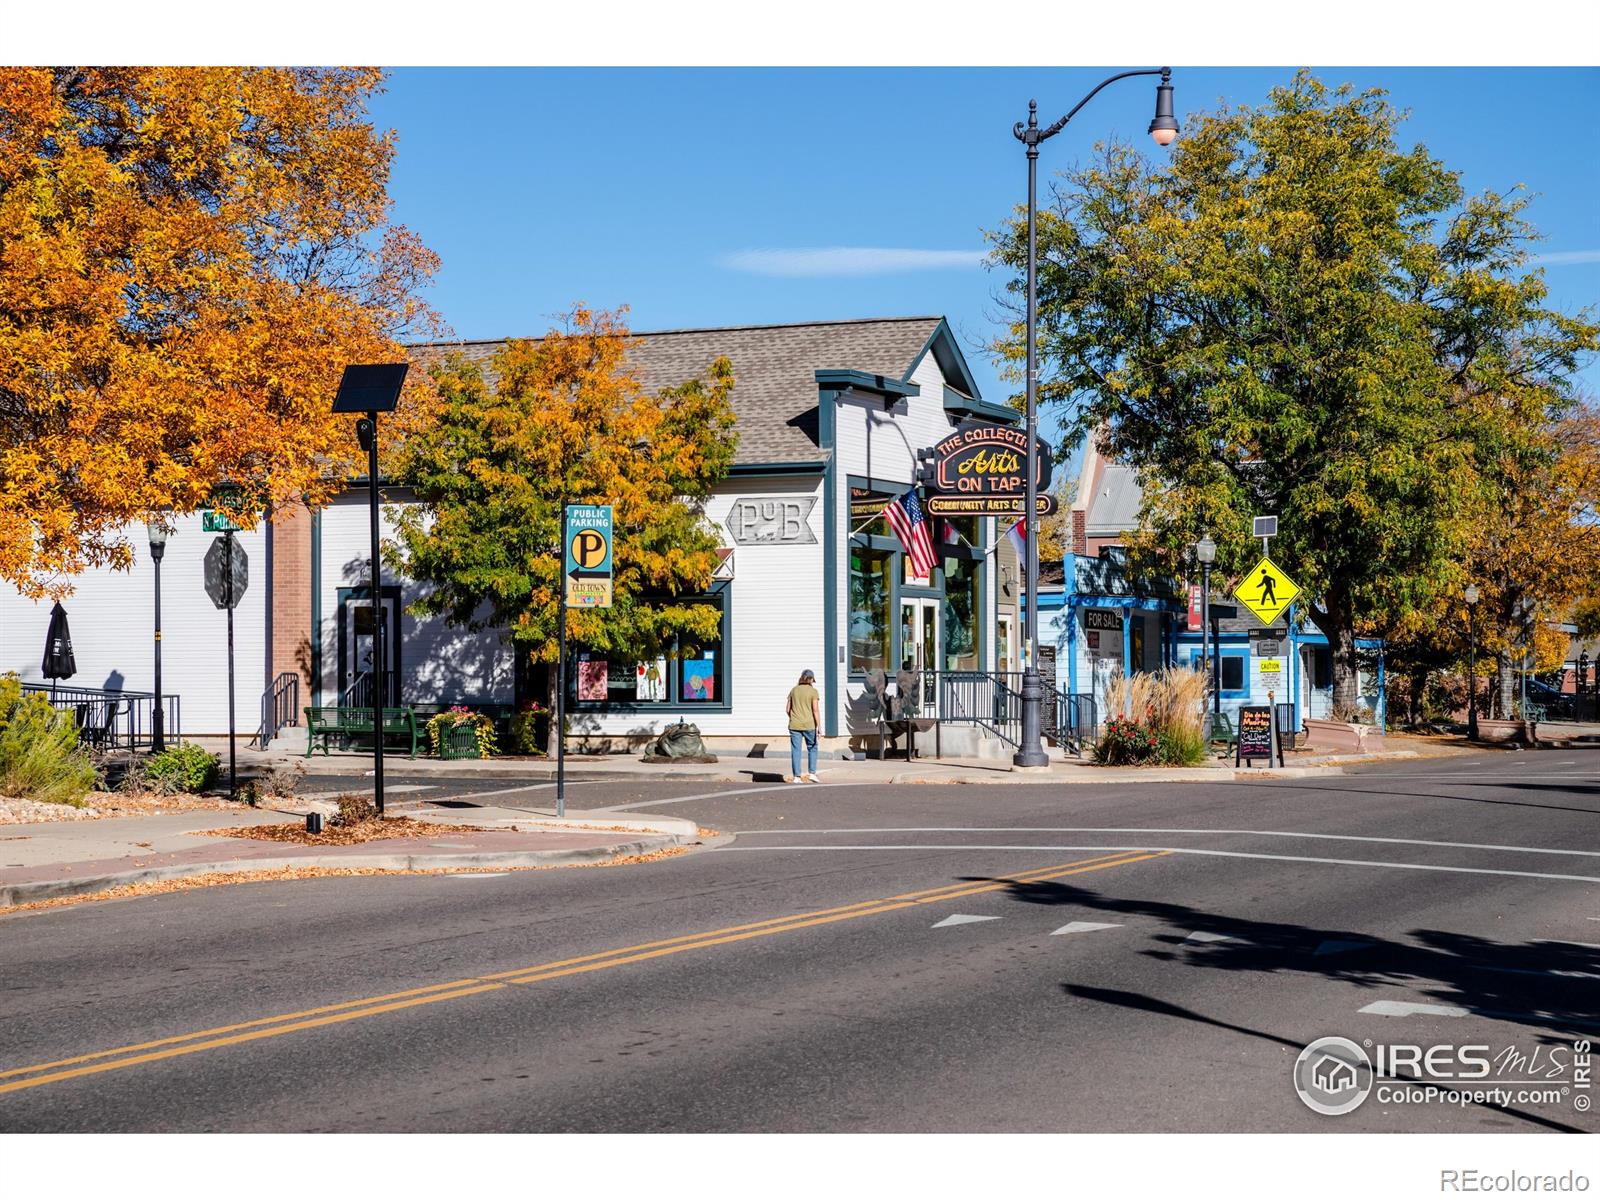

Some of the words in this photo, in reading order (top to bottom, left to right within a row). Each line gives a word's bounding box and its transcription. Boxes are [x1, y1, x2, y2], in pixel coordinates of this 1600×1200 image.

[937, 435, 962, 456] THE
[964, 427, 1041, 451] COLLECTI
[958, 448, 1020, 474] Arts
[957, 477, 982, 492] ON
[988, 477, 1021, 491] TAP
[931, 500, 985, 511] COMMUNITY
[987, 500, 1010, 511] ARTS
[1012, 500, 1047, 510] CER
[573, 509, 606, 519] PUBLIC
[571, 519, 609, 527] PARKING
[1088, 612, 1103, 627] FOR
[1103, 614, 1120, 629] SALE
